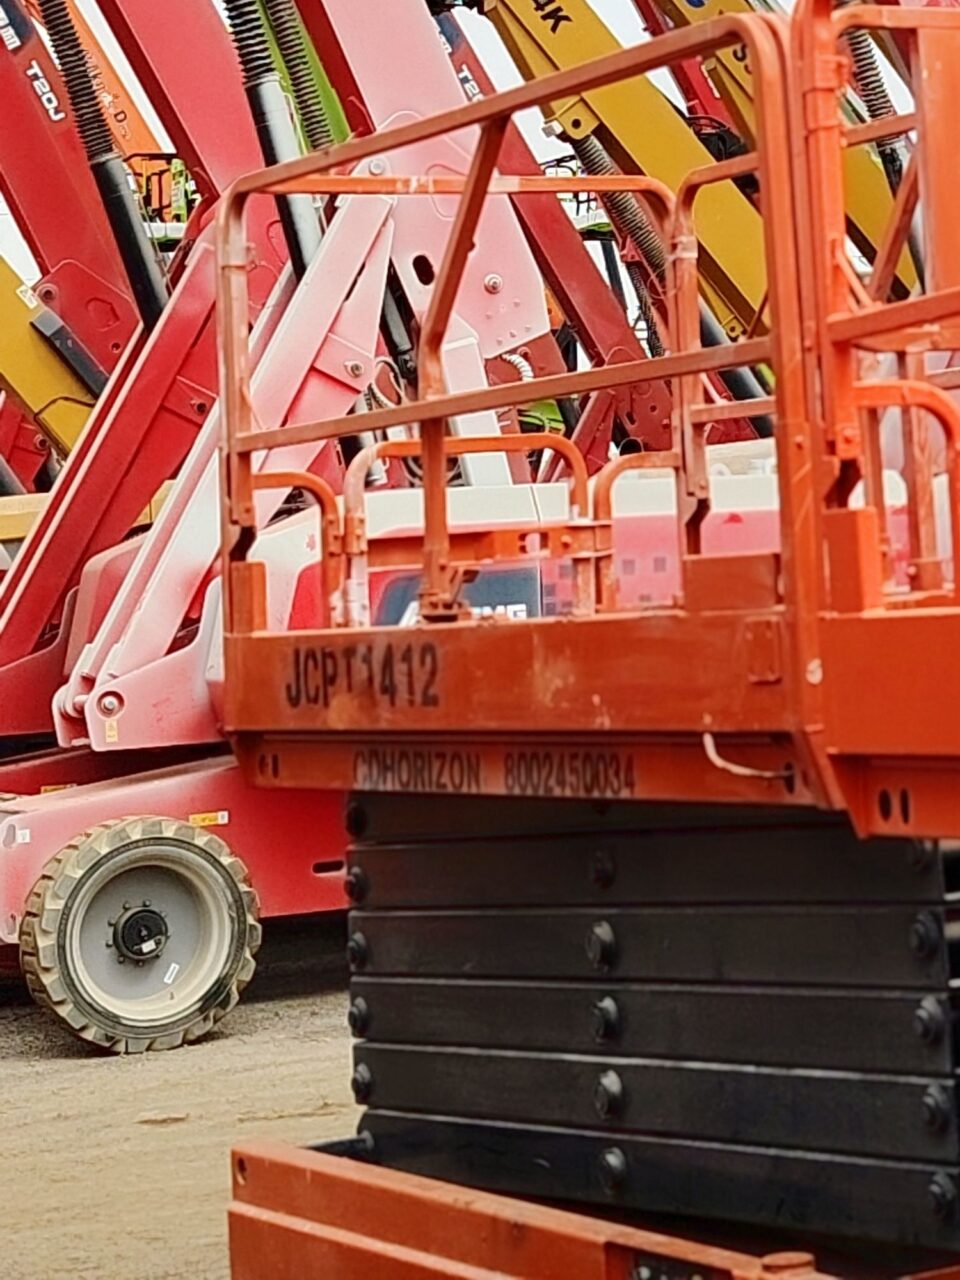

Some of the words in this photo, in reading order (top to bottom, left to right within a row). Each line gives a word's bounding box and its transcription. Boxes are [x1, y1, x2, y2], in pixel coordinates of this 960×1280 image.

[26, 60, 65, 122] T20J
[286, 643, 440, 709] JCPT1412
[353, 749, 482, 791] CDHORIZON
